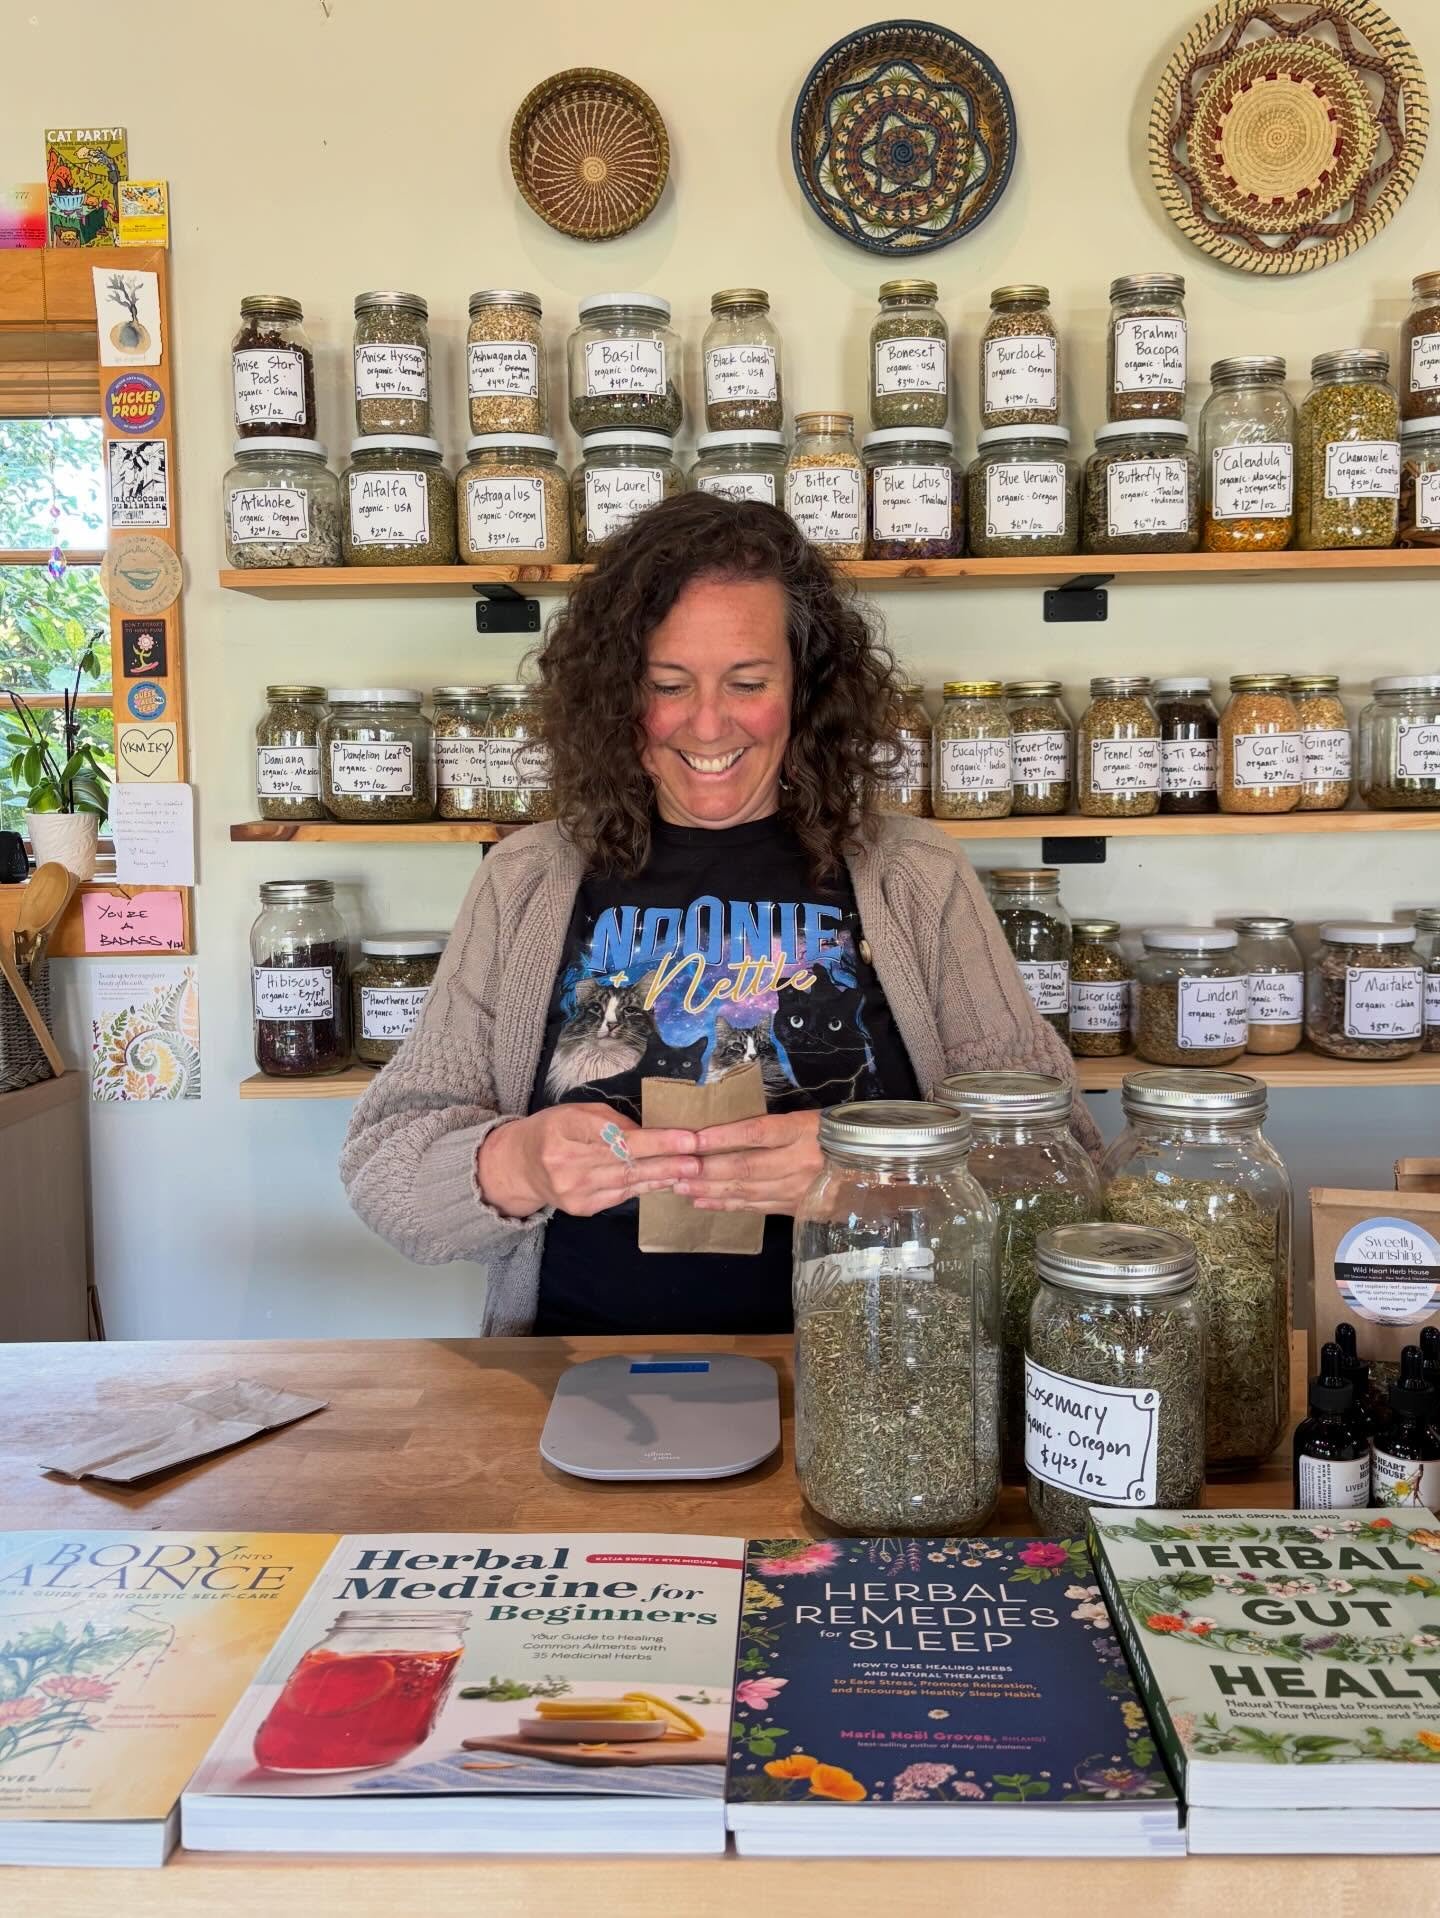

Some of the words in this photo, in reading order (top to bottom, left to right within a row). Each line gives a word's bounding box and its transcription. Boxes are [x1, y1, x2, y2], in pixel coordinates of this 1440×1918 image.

[47, 130, 73, 142] CAT
[76, 129, 123, 142] PARTY!
[1132, 324, 1179, 341] Brahmi
[361, 350, 388, 363] Anise
[601, 343, 641, 364] Basil
[712, 352, 737, 367] Black
[887, 343, 936, 361] Boneset
[996, 344, 1047, 362] Burdock
[1135, 343, 1180, 360] Bacopa
[267, 355, 297, 371] Star
[921, 361, 937, 372] USA
[1162, 358, 1183, 369] India
[252, 371, 280, 385] Pods
[748, 368, 765, 378] USA
[110, 390, 161, 406] WICKED
[111, 404, 156, 418] PROUD
[1223, 451, 1281, 471] Calendula
[1338, 447, 1390, 464] Chamomile
[806, 471, 841, 487] Bitter
[884, 475, 905, 492] Blue
[912, 474, 941, 489] Lotus
[998, 470, 1020, 486] Blue
[1117, 466, 1162, 485] Butterfly
[1165, 465, 1181, 482] Pea
[361, 479, 408, 499] Alfalfa
[594, 479, 611, 495] Bay
[615, 476, 651, 492] Laurel
[240, 494, 296, 511] Artichoke
[473, 484, 531, 509] Astragalus
[794, 491, 829, 512] Orange
[832, 489, 855, 505] Peel
[393, 503, 412, 513] USA
[952, 742, 1005, 760] Eucalyptus
[1103, 745, 1133, 761] Fennel
[1191, 747, 1213, 758] Root
[1252, 740, 1296, 757] Garlic
[1303, 737, 1345, 753] Ginger
[264, 753, 306, 766] Damiana
[342, 749, 381, 762] Dandelion
[384, 748, 403, 761] Leaf
[120, 922, 134, 930] A
[100, 934, 163, 947] BADASS
[585, 895, 843, 975] NOONIE
[267, 975, 320, 989] Hibiscus
[642, 951, 818, 1015] Nettle
[1253, 980, 1286, 993] Maca
[1364, 976, 1415, 993] Maitake
[299, 987, 326, 1001] Egypt
[1078, 989, 1121, 1002] Licorice
[1196, 986, 1239, 1003] Linden
[1365, 1235, 1414, 1251] Sweetly
[1359, 1247, 1423, 1265] Nourishing
[1352, 1266, 1368, 1274] Wild
[1368, 1266, 1388, 1274] Heart
[1389, 1267, 1407, 1275] Herb
[1407, 1268, 1430, 1276] House
[1026, 1371, 1108, 1436] Rosemary
[1068, 1430, 1131, 1461] Oregon
[1378, 1456, 1406, 1473] HEART
[1378, 1466, 1406, 1481] HOUSE
[44, 1543, 249, 1569] BODY
[232, 1553, 274, 1561] INTO
[349, 1547, 570, 1571] Herbal
[1149, 1544, 1425, 1571] HERBAL
[112, 1592, 191, 1600] HOLISTIC
[193, 1592, 282, 1600] SELF-CARE
[332, 1574, 638, 1601] Medicine
[641, 1583, 705, 1603] for
[824, 1582, 1029, 1603] HERBAL
[485, 1603, 720, 1626] Beginners
[795, 1604, 1060, 1628] REMEDIES
[1241, 1598, 1393, 1628] GUT
[530, 1633, 560, 1641] Your
[561, 1633, 599, 1641] Guide
[617, 1634, 665, 1644] Healing
[819, 1629, 843, 1639] for
[849, 1629, 1013, 1653] SLEEP
[522, 1642, 580, 1650] Common
[582, 1643, 637, 1651] Ailments
[640, 1644, 667, 1652] with
[550, 1652, 612, 1660] Medicinal
[614, 1652, 652, 1661] Herbs
[884, 1662, 899, 1670] TO
[925, 1663, 975, 1672] HEALING
[891, 1671, 942, 1679] NATURAL
[943, 1672, 1005, 1681] THERAPIES
[919, 1680, 969, 1689] Promote
[855, 1687, 917, 1697] Encourage
[920, 1688, 966, 1698] Healthy
[969, 1690, 1001, 1699] Sleep
[1003, 1690, 1042, 1699] Habits
[1225, 1698, 1273, 1709] Natural
[1276, 1700, 1338, 1712] Therapies
[1340, 1701, 1355, 1711] to
[1359, 1702, 1411, 1711] Promote
[1228, 1708, 1266, 1719] Boost
[1268, 1709, 1300, 1720] Your
[1385, 1713, 1411, 1721] and
[840, 1729, 886, 1740] Maria
